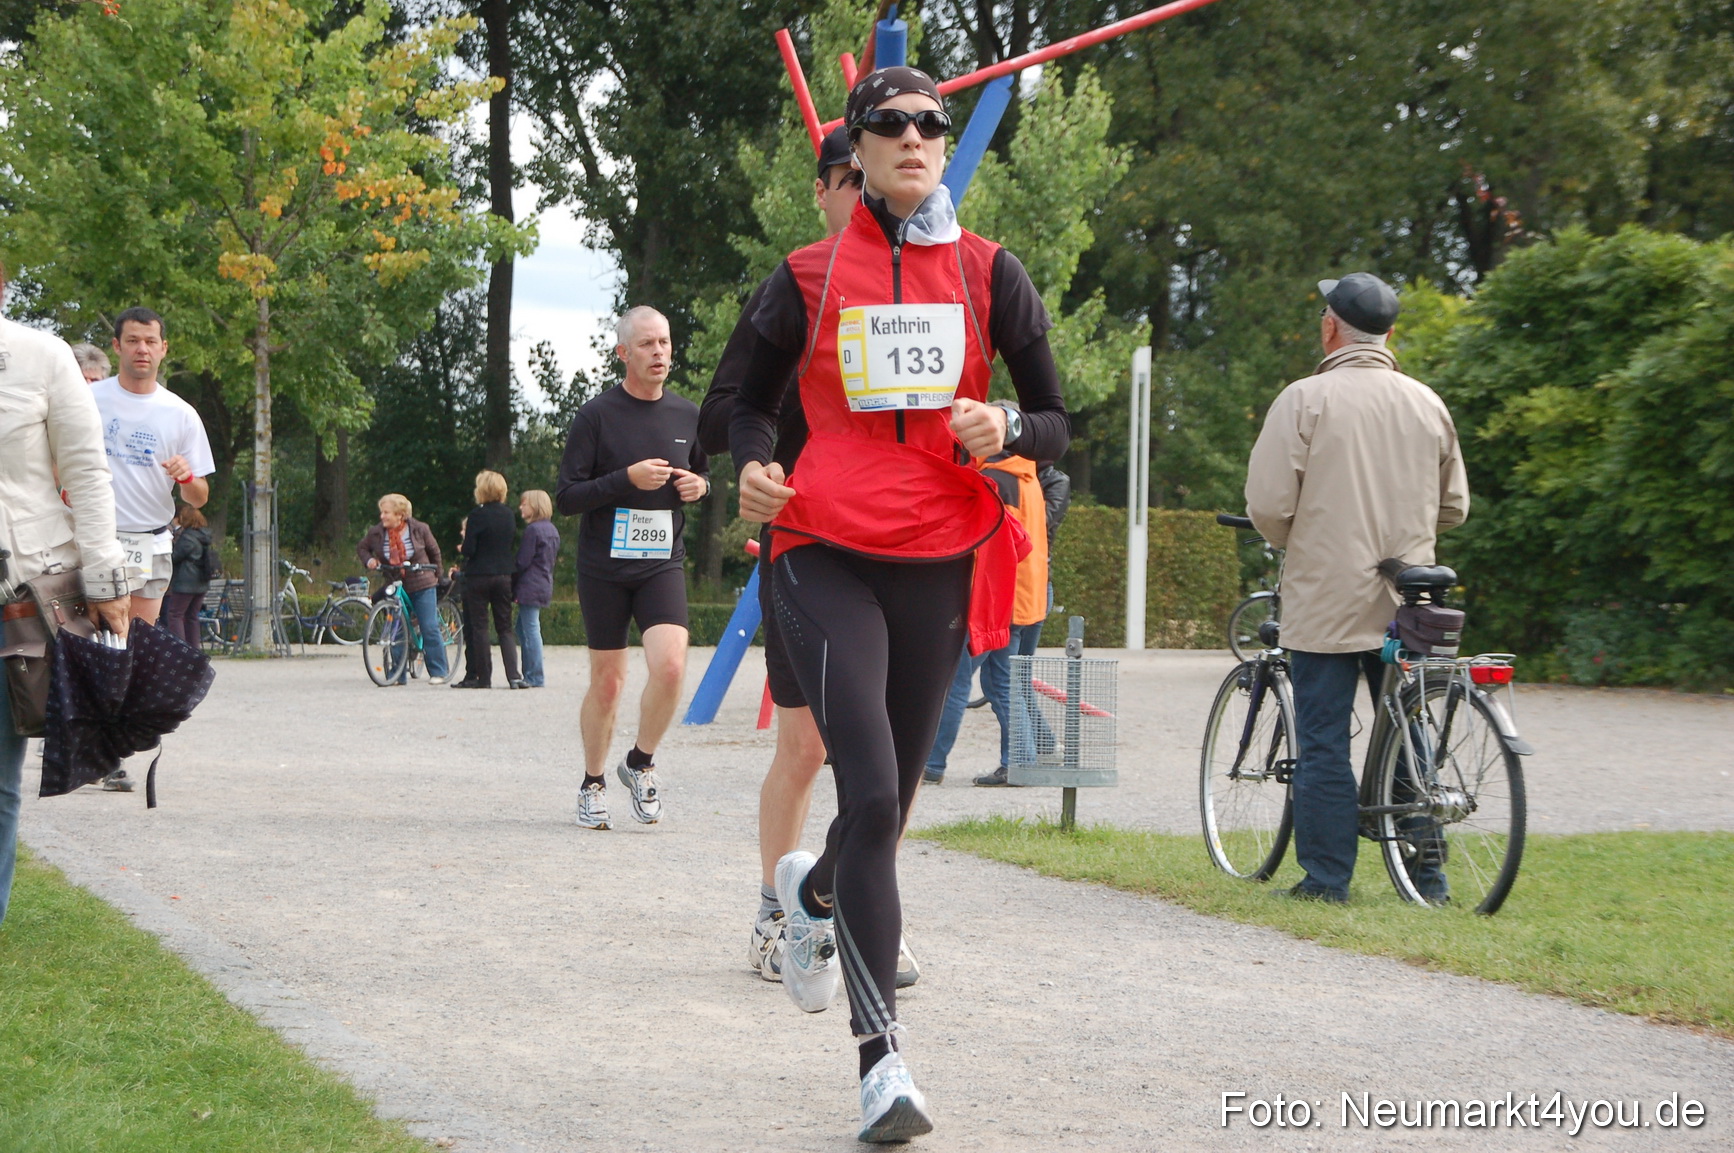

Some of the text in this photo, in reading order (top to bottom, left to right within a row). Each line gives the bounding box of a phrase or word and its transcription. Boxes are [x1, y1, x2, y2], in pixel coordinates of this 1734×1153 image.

[871, 315, 931, 335] Kathrin
[887, 346, 945, 375] 133
[632, 514, 653, 524] Peter
[632, 528, 666, 542] 2899
[123, 550, 142, 564] 78
